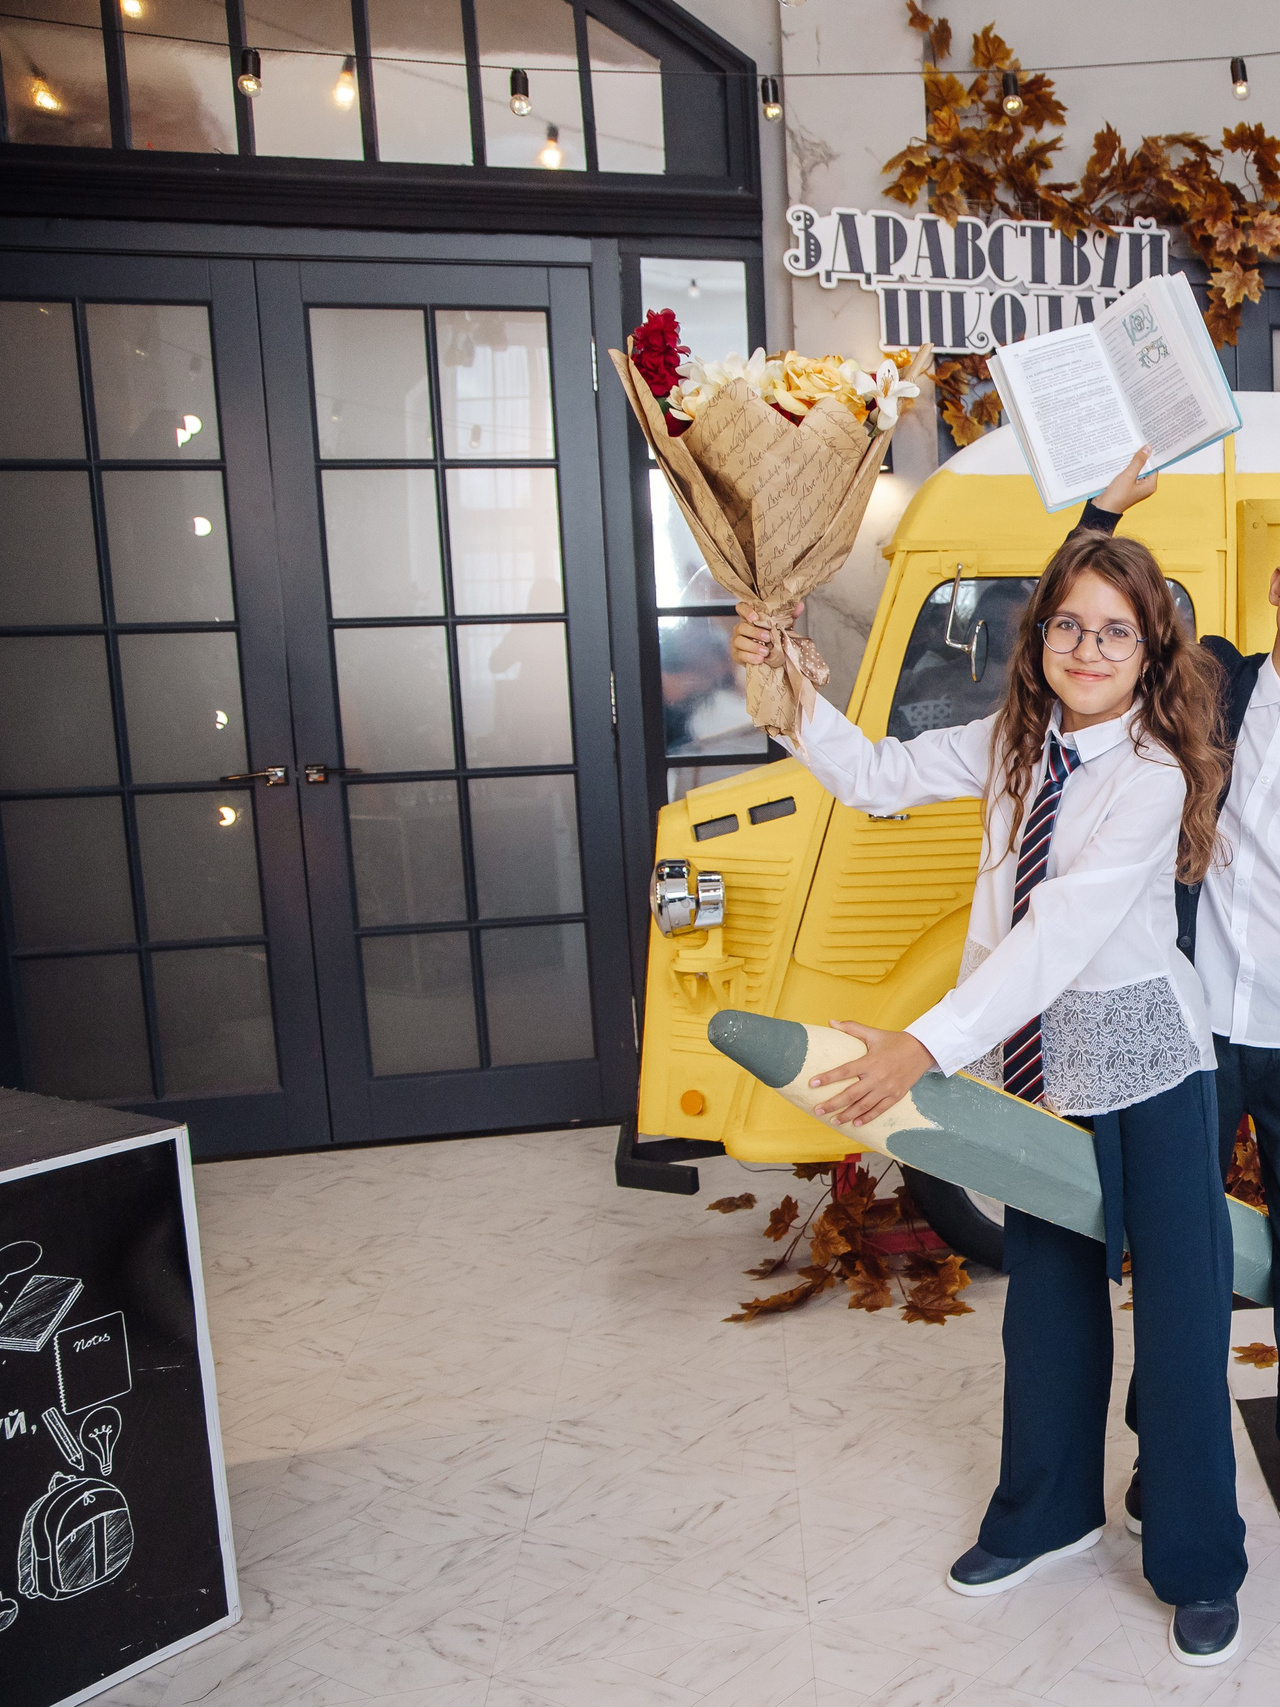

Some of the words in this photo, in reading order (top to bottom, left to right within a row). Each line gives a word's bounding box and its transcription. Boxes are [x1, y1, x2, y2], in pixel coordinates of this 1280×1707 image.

[788, 209, 1167, 289] ЗДРАВСТВУЙ
[883, 287, 1117, 347] ШКОЛ
[747, 451, 764, 469] Love
[800, 479, 816, 501] Love
[767, 491, 784, 511] Love
[771, 543, 787, 560] Love
[73, 1333, 110, 1352] Notes
